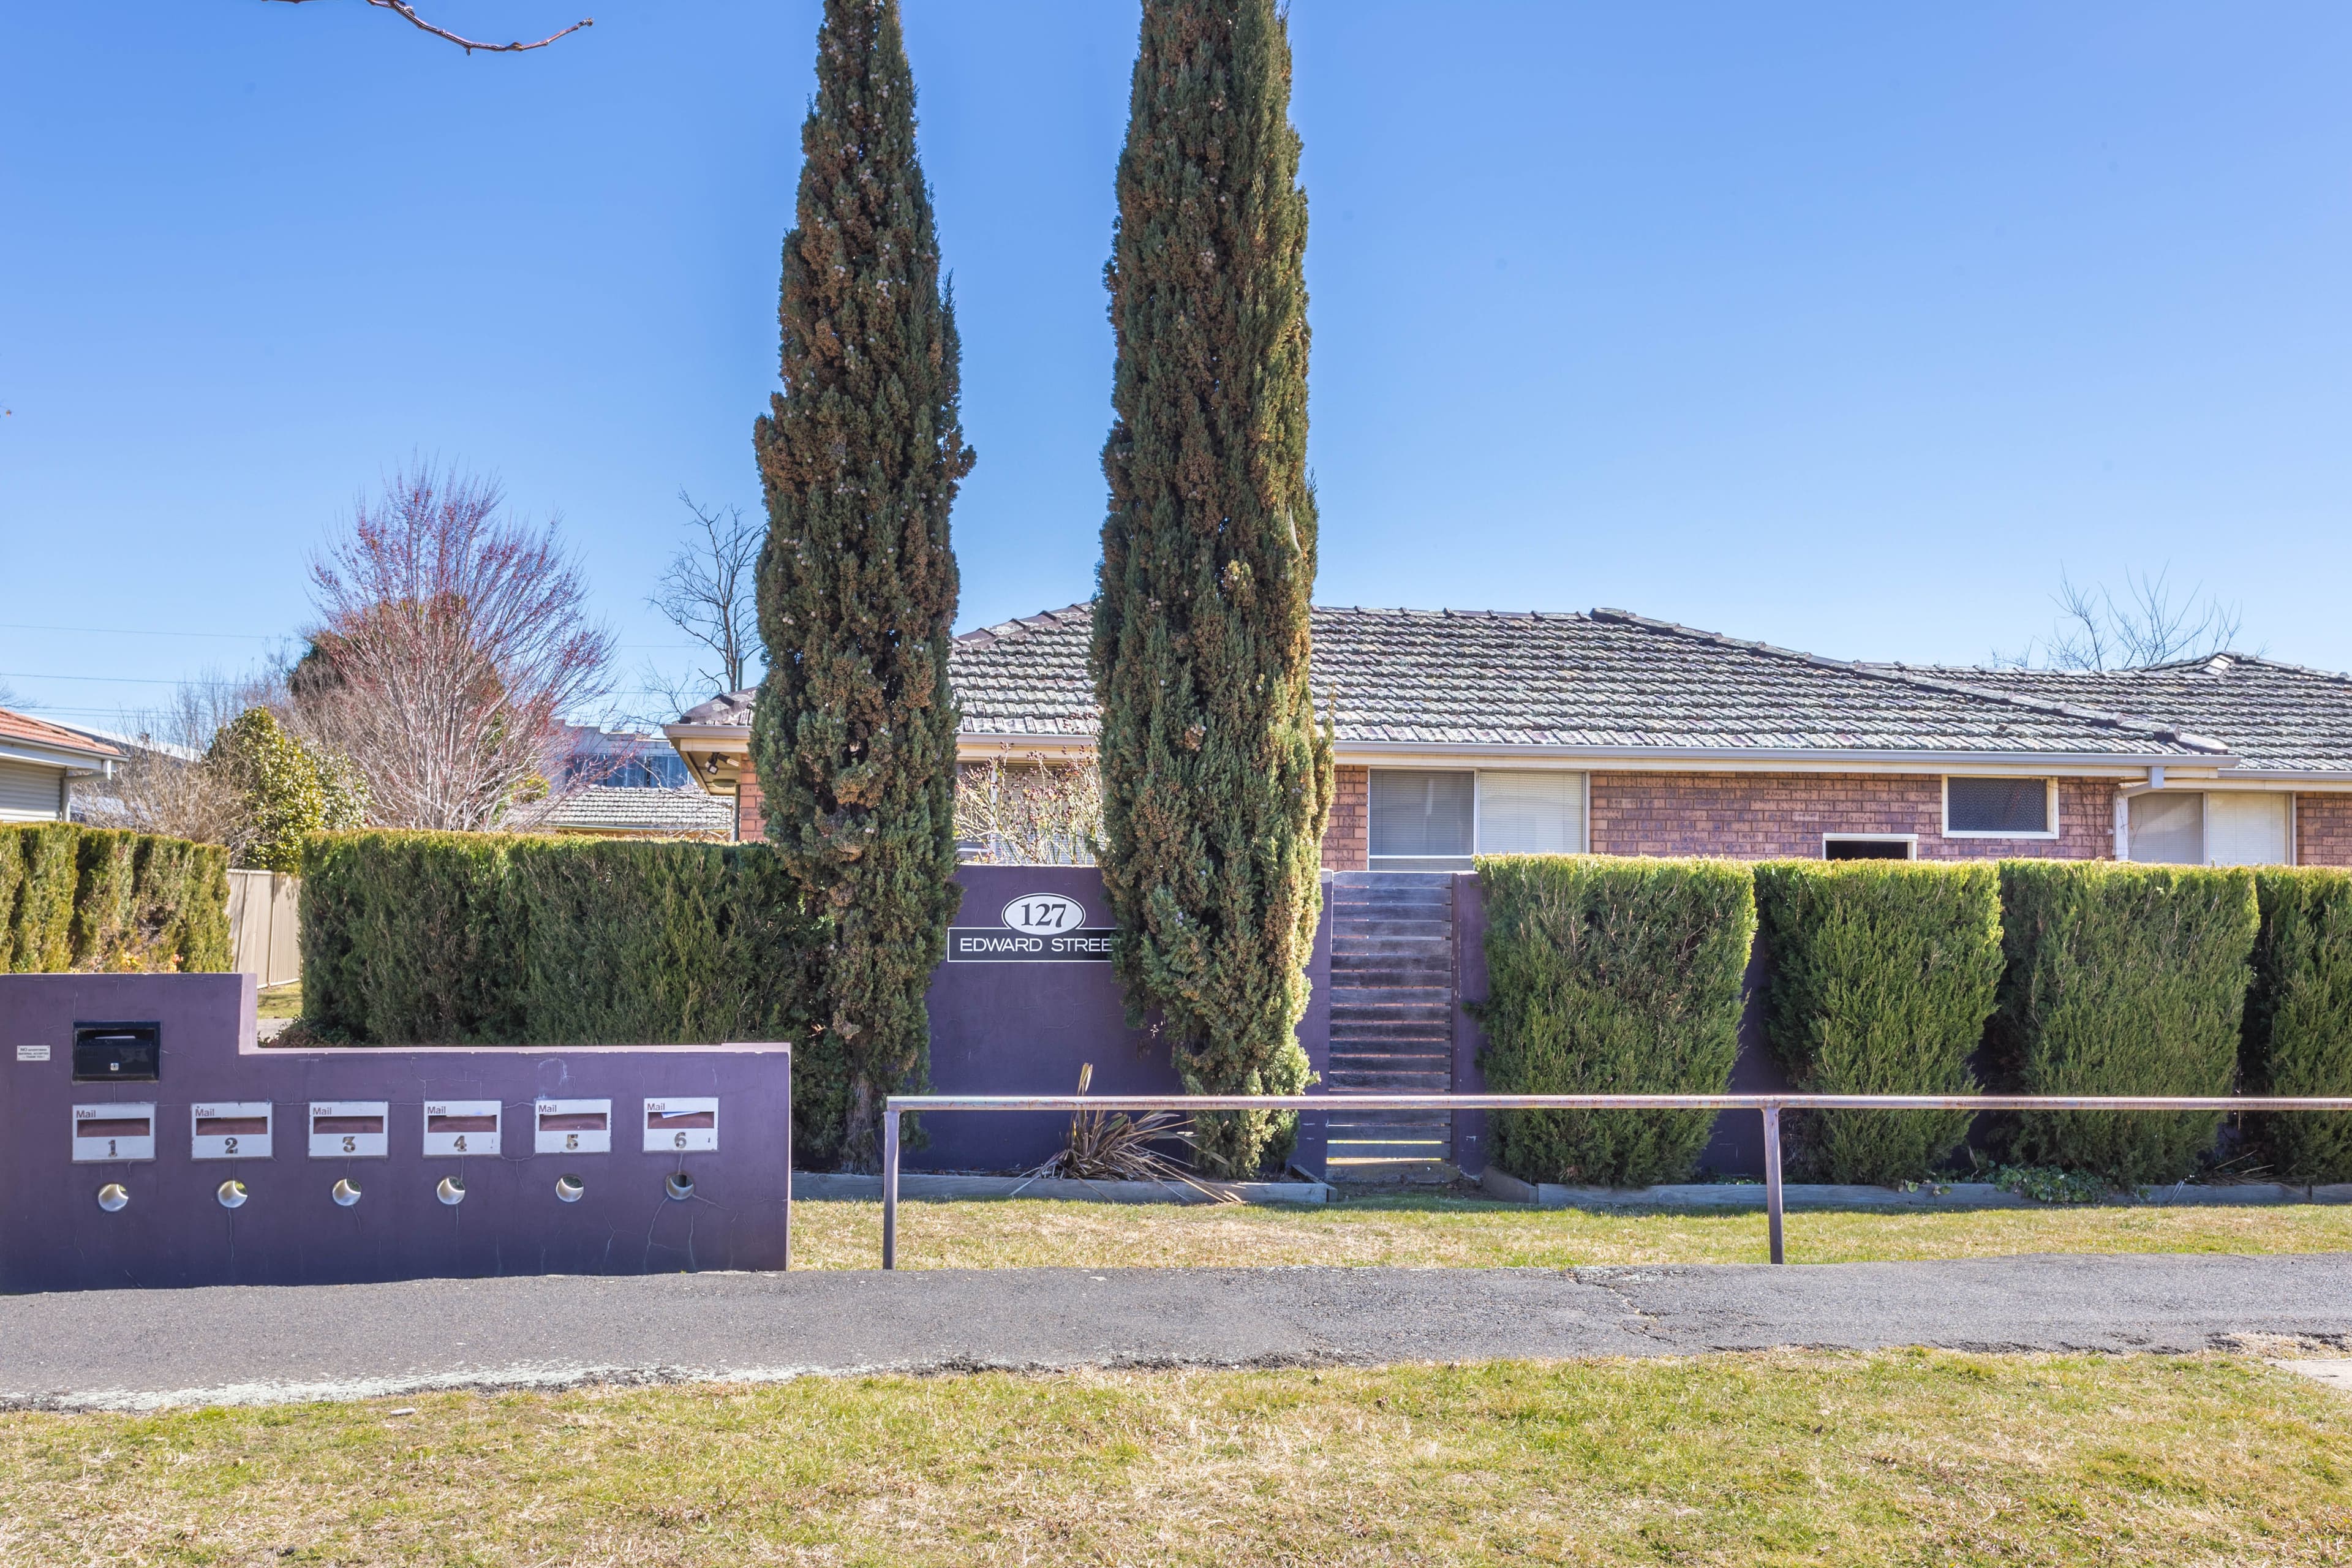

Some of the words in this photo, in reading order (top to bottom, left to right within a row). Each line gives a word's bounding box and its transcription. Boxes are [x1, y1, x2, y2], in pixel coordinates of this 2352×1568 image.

[1020, 903, 1066, 927] 127
[960, 938, 1042, 952] EDWARD
[313, 1107, 332, 1115] Mail
[108, 1139, 118, 1157] 1
[225, 1137, 238, 1154] 2
[342, 1136, 356, 1153] 3
[454, 1135, 467, 1152] 4
[566, 1134, 578, 1150] 5
[674, 1132, 687, 1148] 6
